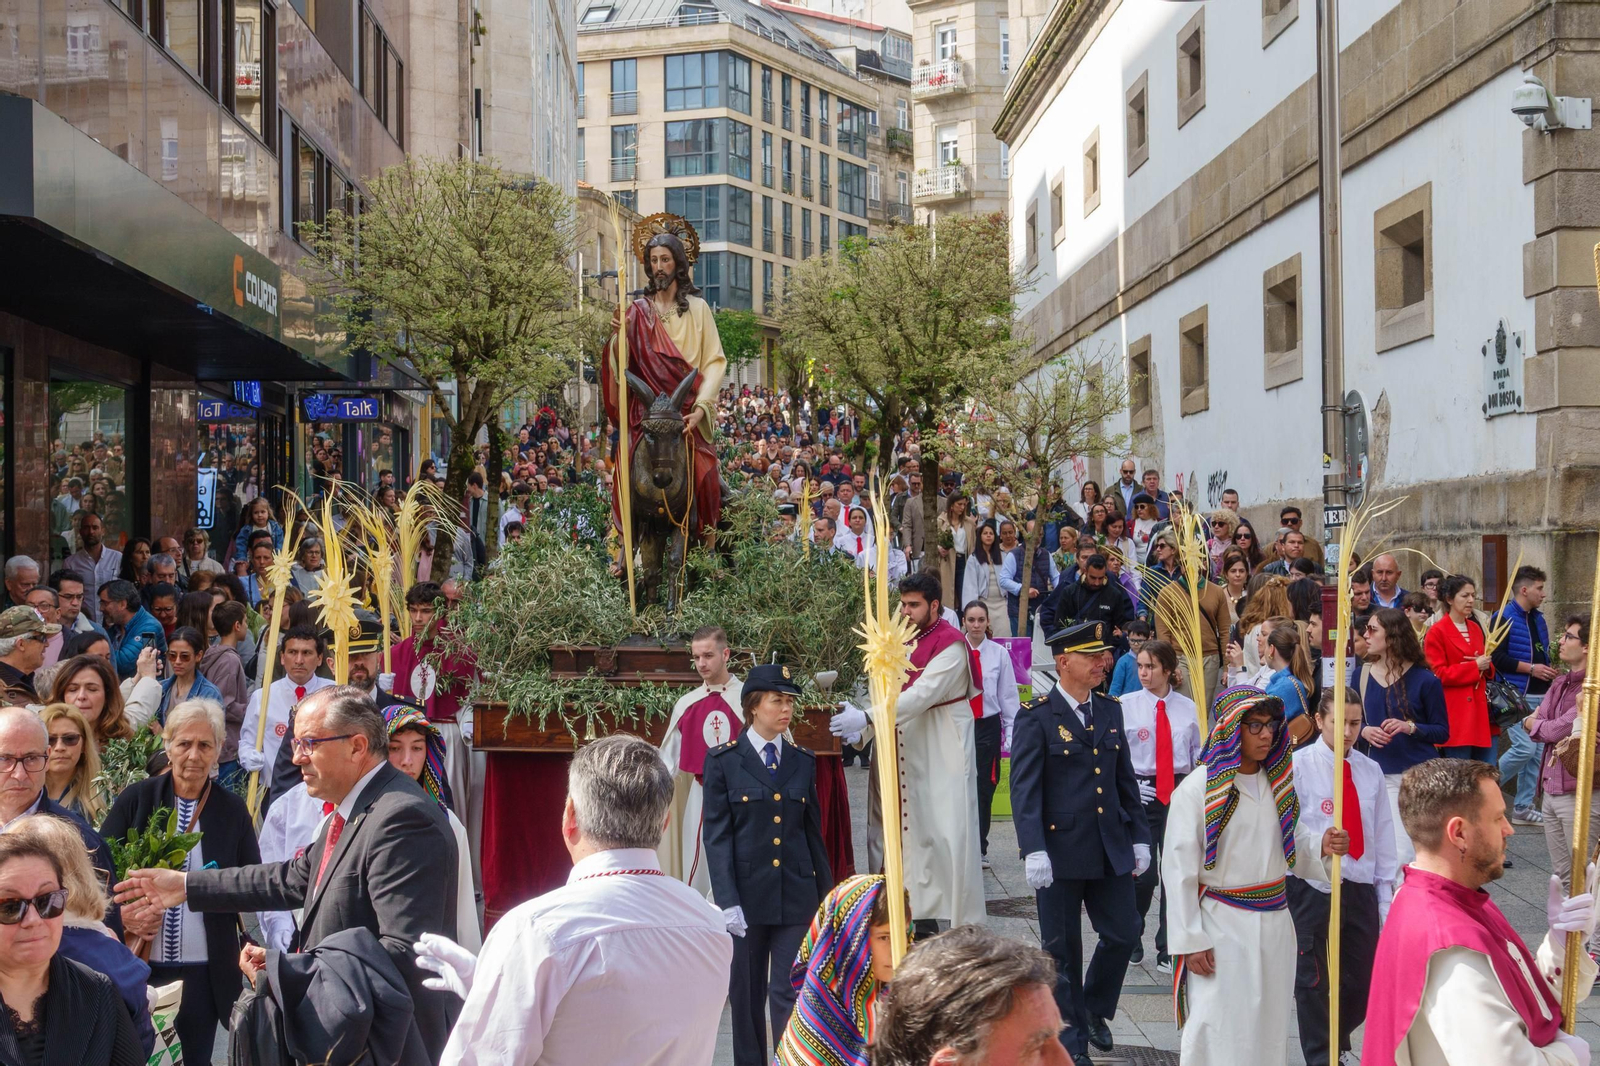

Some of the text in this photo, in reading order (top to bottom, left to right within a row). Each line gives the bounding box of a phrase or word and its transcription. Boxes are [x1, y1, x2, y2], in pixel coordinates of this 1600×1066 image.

[1493, 368, 1510, 380] RONDA
[1498, 381, 1505, 390] DE
[1488, 390, 1516, 409] DON BOSCO
[342, 400, 373, 417] Talk
